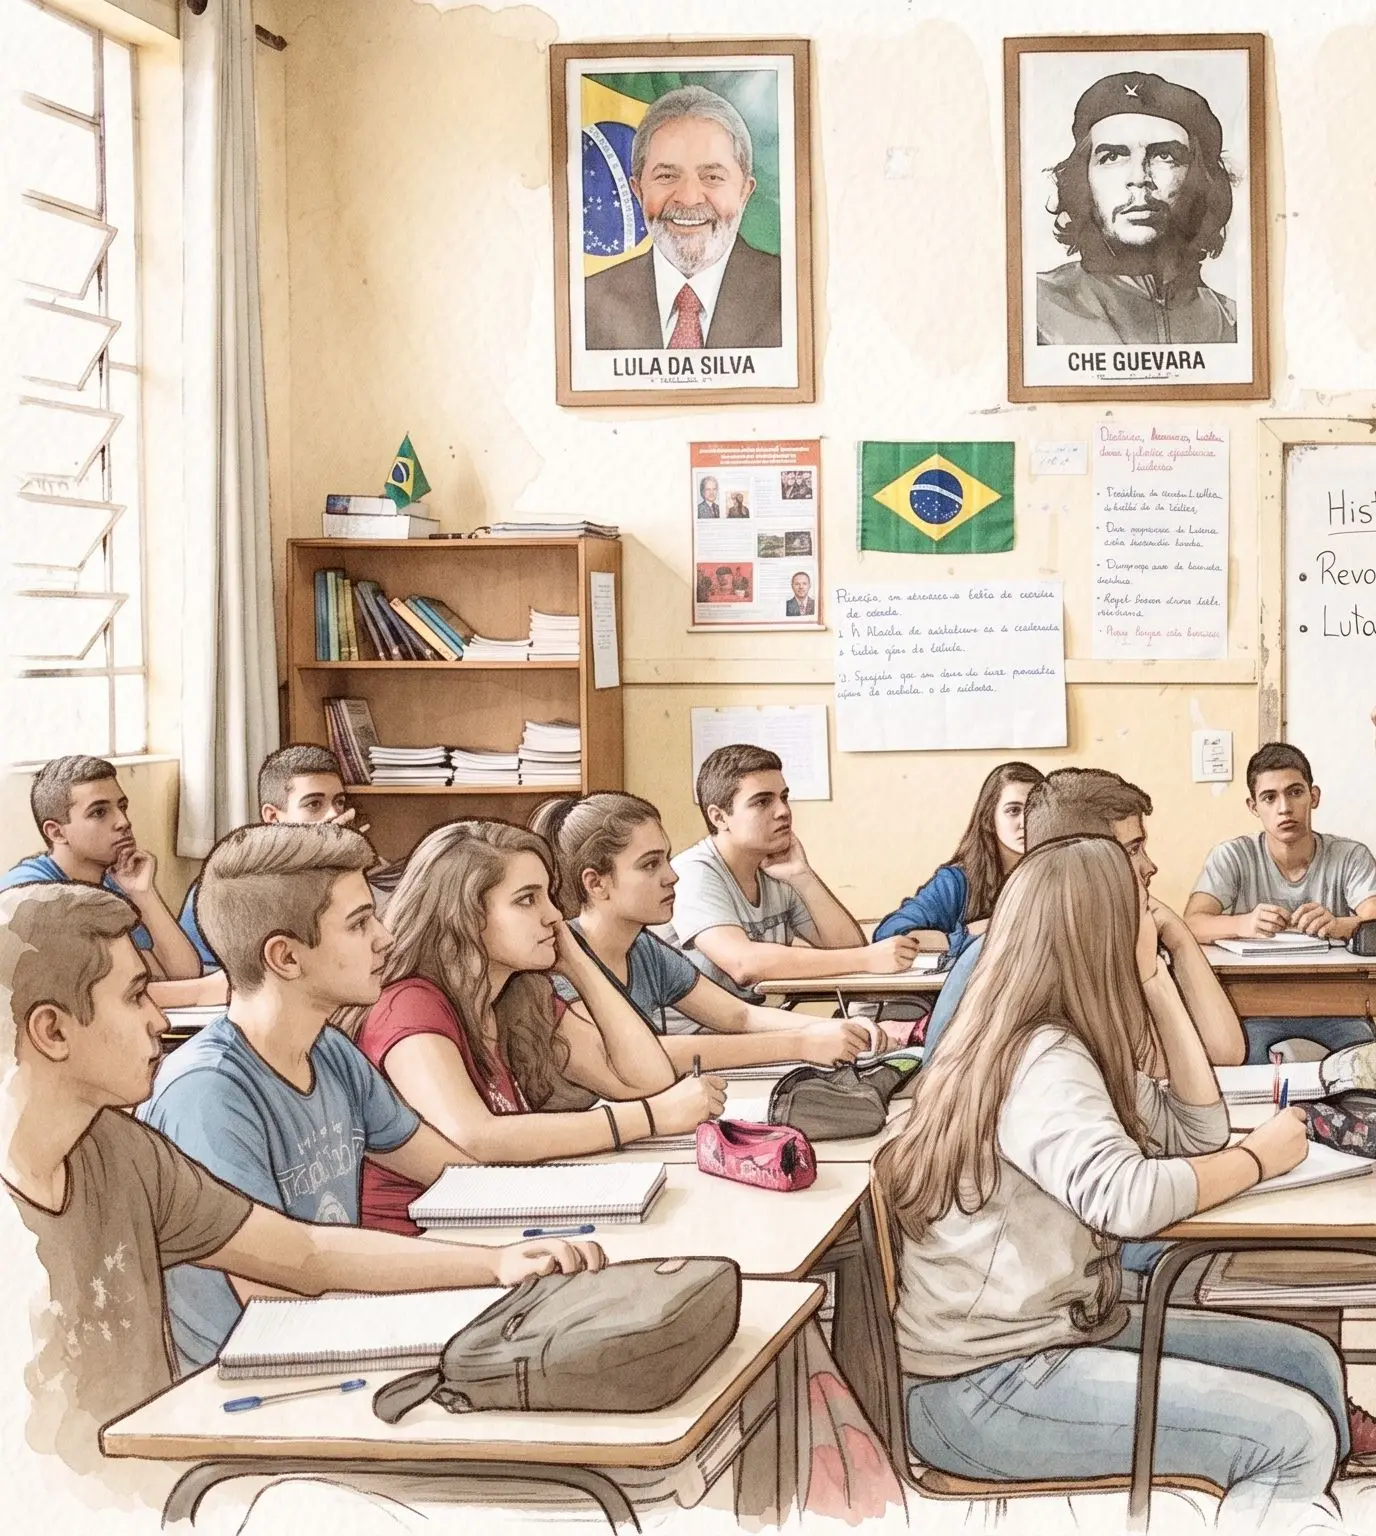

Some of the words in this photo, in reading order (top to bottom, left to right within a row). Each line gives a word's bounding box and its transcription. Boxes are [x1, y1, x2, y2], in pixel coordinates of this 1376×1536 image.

[613, 357, 662, 376] LULA
[668, 356, 694, 375] DA
[701, 355, 756, 375] SILVA
[1068, 352, 1107, 371] CHE
[1113, 350, 1206, 372] GUEVARA
